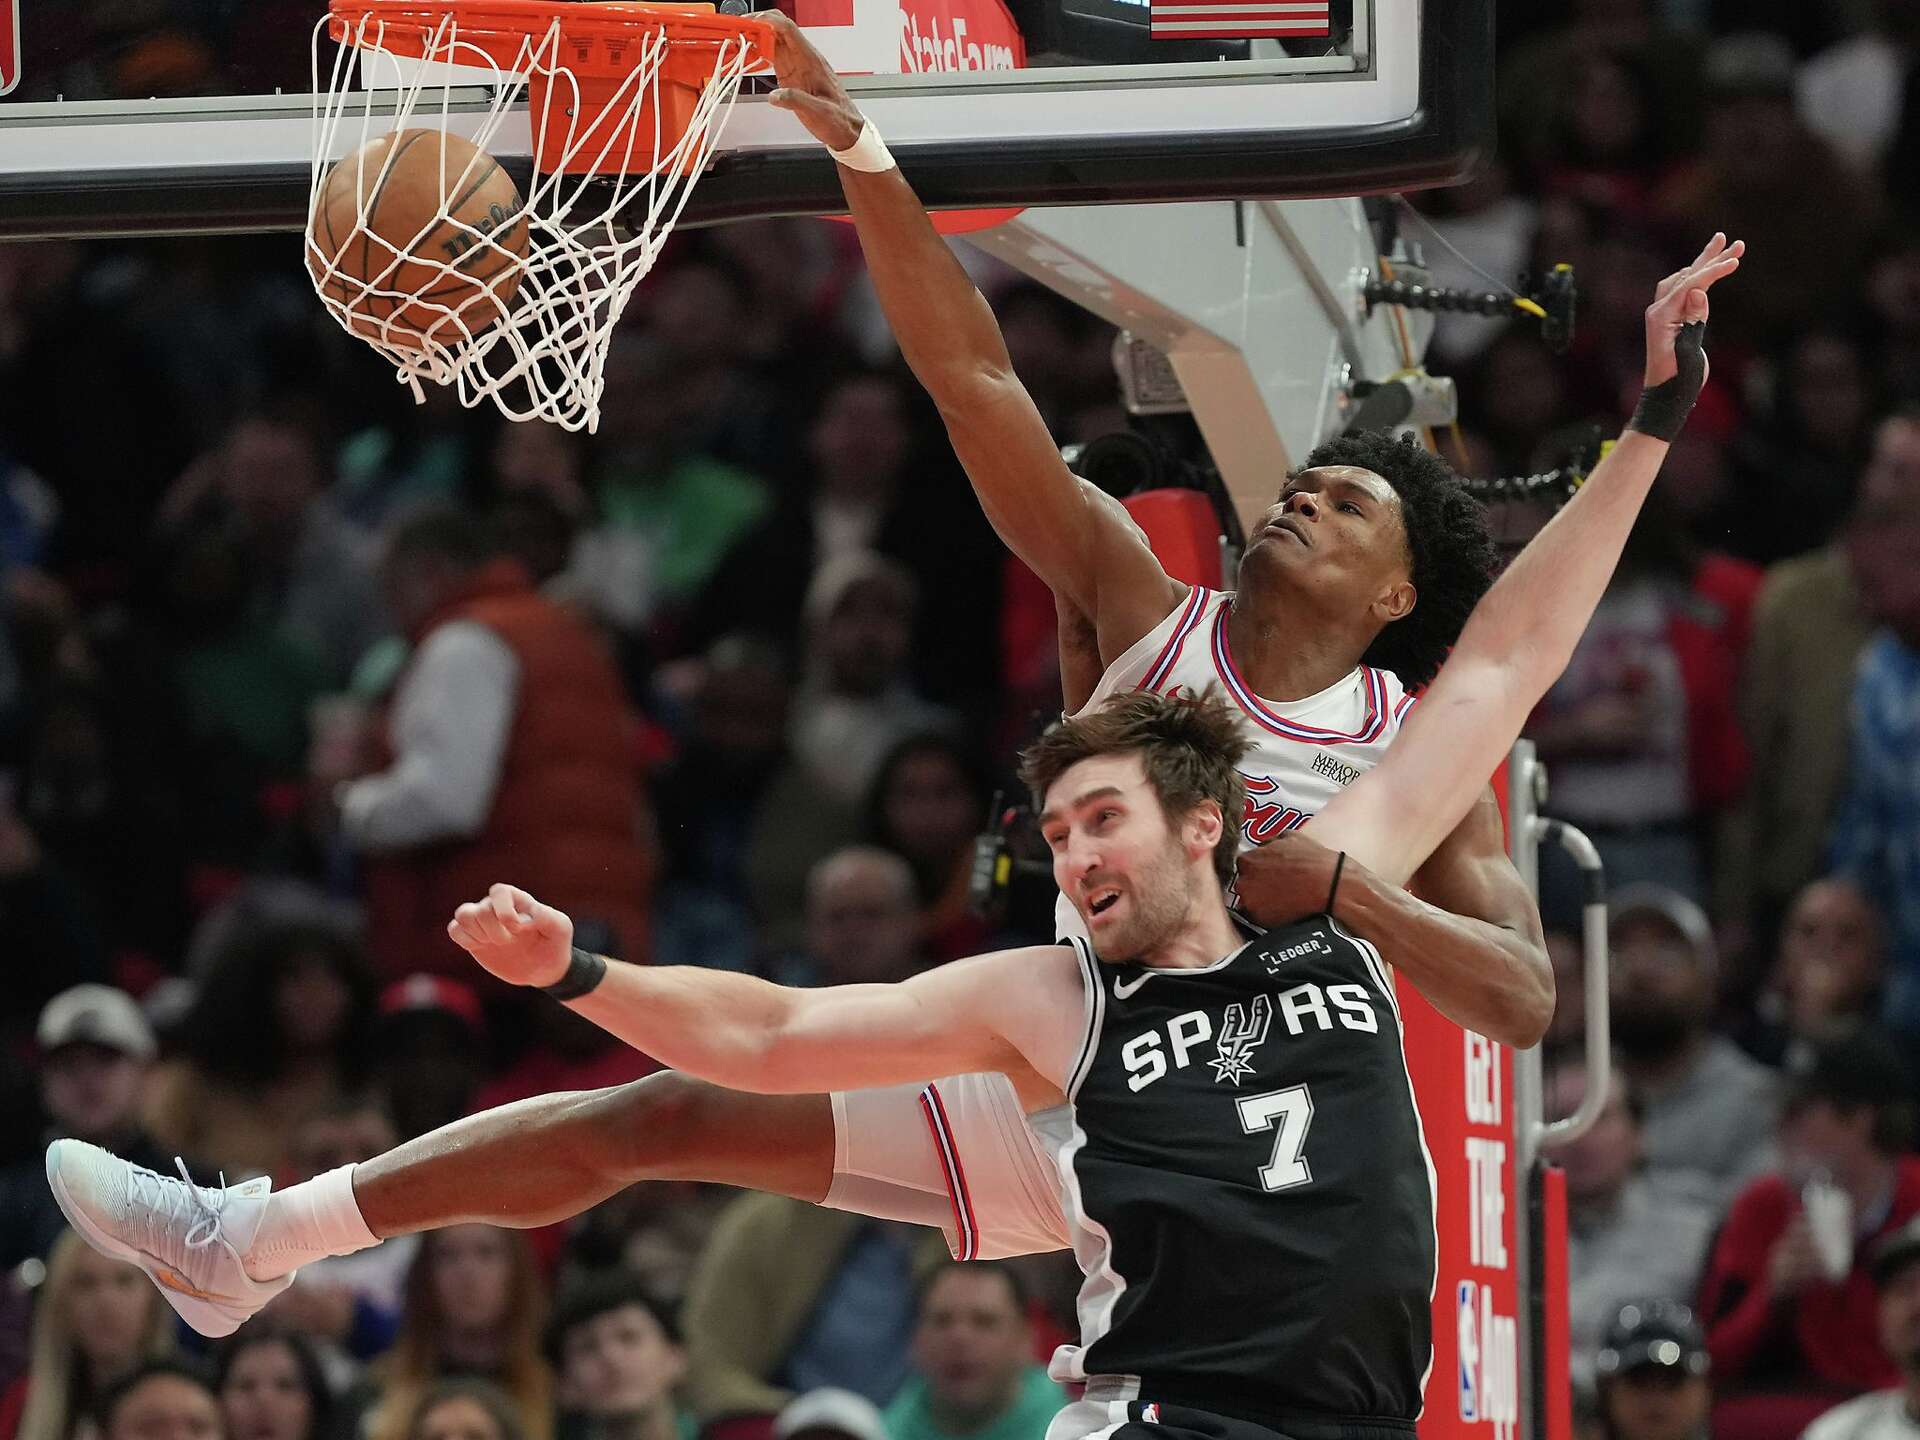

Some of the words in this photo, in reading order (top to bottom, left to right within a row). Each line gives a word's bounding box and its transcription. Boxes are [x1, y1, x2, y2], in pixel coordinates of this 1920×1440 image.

[1311, 762, 1350, 786] HERM
[1313, 752, 1361, 781] MEMOR
[1270, 940, 1321, 965] LEDGER
[1121, 982, 1379, 1093] SPURS
[1234, 1082, 1315, 1193] 7
[1465, 1136, 1508, 1270] THE
